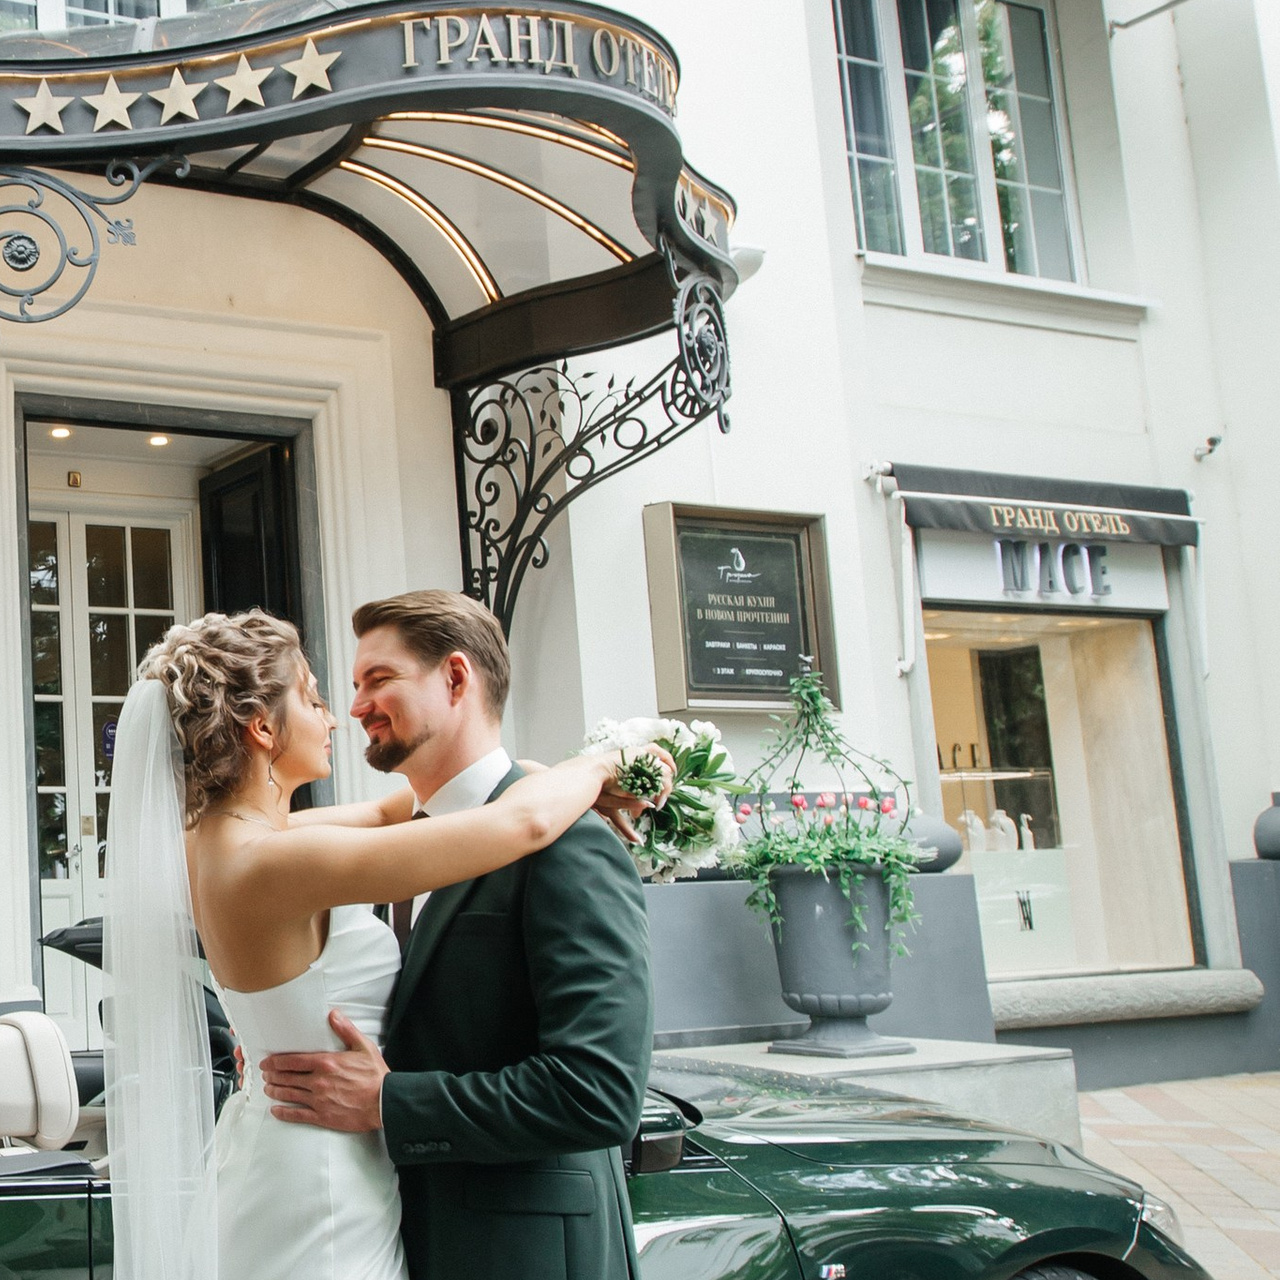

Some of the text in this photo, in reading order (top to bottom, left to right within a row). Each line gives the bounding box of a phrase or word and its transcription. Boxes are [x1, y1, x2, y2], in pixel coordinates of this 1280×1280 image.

[399, 13, 580, 79] ГРАНД
[989, 505, 1131, 535] ГРАНД ОТЕЛЬ
[707, 593, 776, 608] РУССКАЯ КУХНЯ
[696, 608, 790, 624] В НОВОМ ПРОЧТЕНИИ
